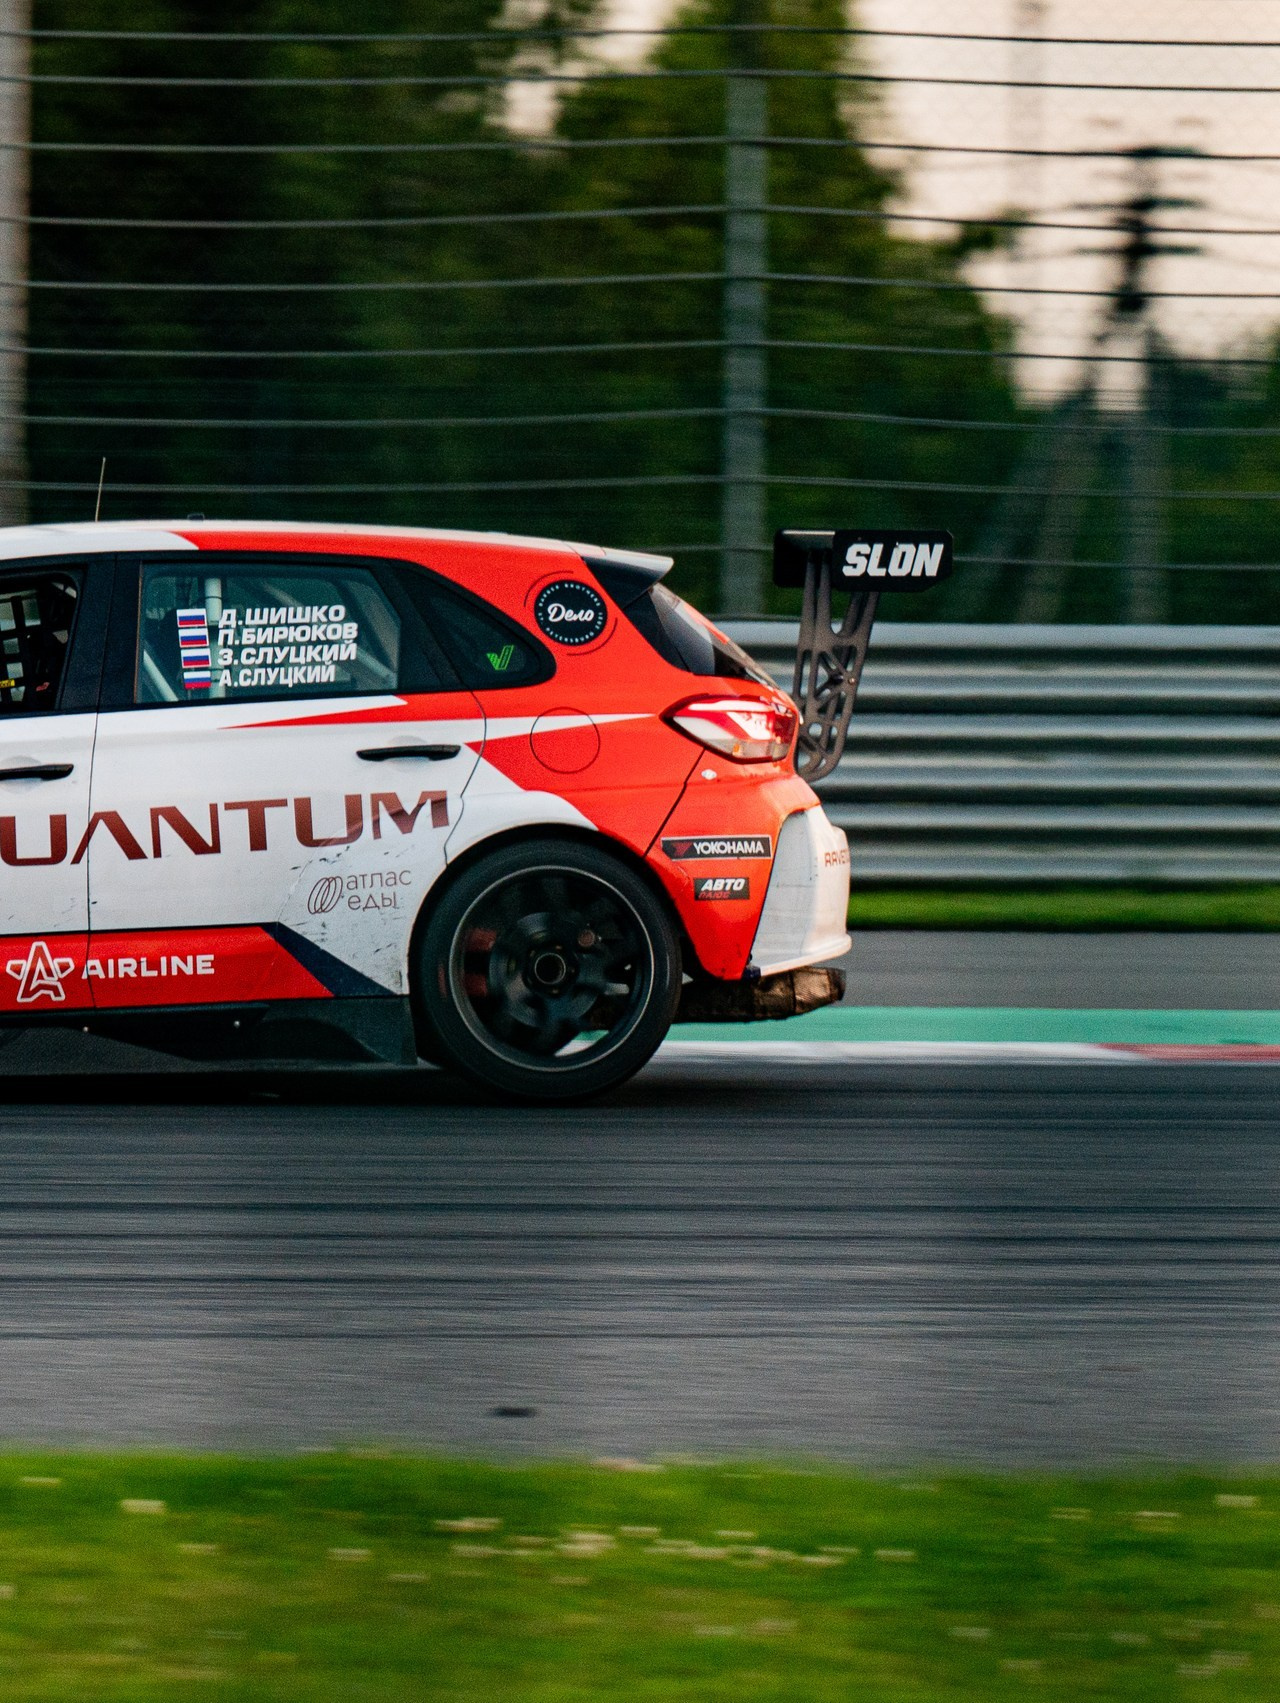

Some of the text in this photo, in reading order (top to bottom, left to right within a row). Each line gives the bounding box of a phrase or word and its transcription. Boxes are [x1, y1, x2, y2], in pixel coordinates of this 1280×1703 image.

[841, 542, 945, 577] SLON
[218, 604, 346, 628] Д.ШИШКО
[547, 602, 595, 622] Дело
[217, 622, 359, 646] П.БИРЮКОВ
[217, 641, 357, 666] З.СЛУЦКИЙ
[218, 659, 336, 688] А.СЛУЦКИЙ
[693, 840, 765, 855] YOKOHAMA
[346, 869, 412, 891] атлас
[700, 878, 746, 892] АВТО
[347, 891, 398, 912] еды
[81, 954, 215, 979] AIRLINE
